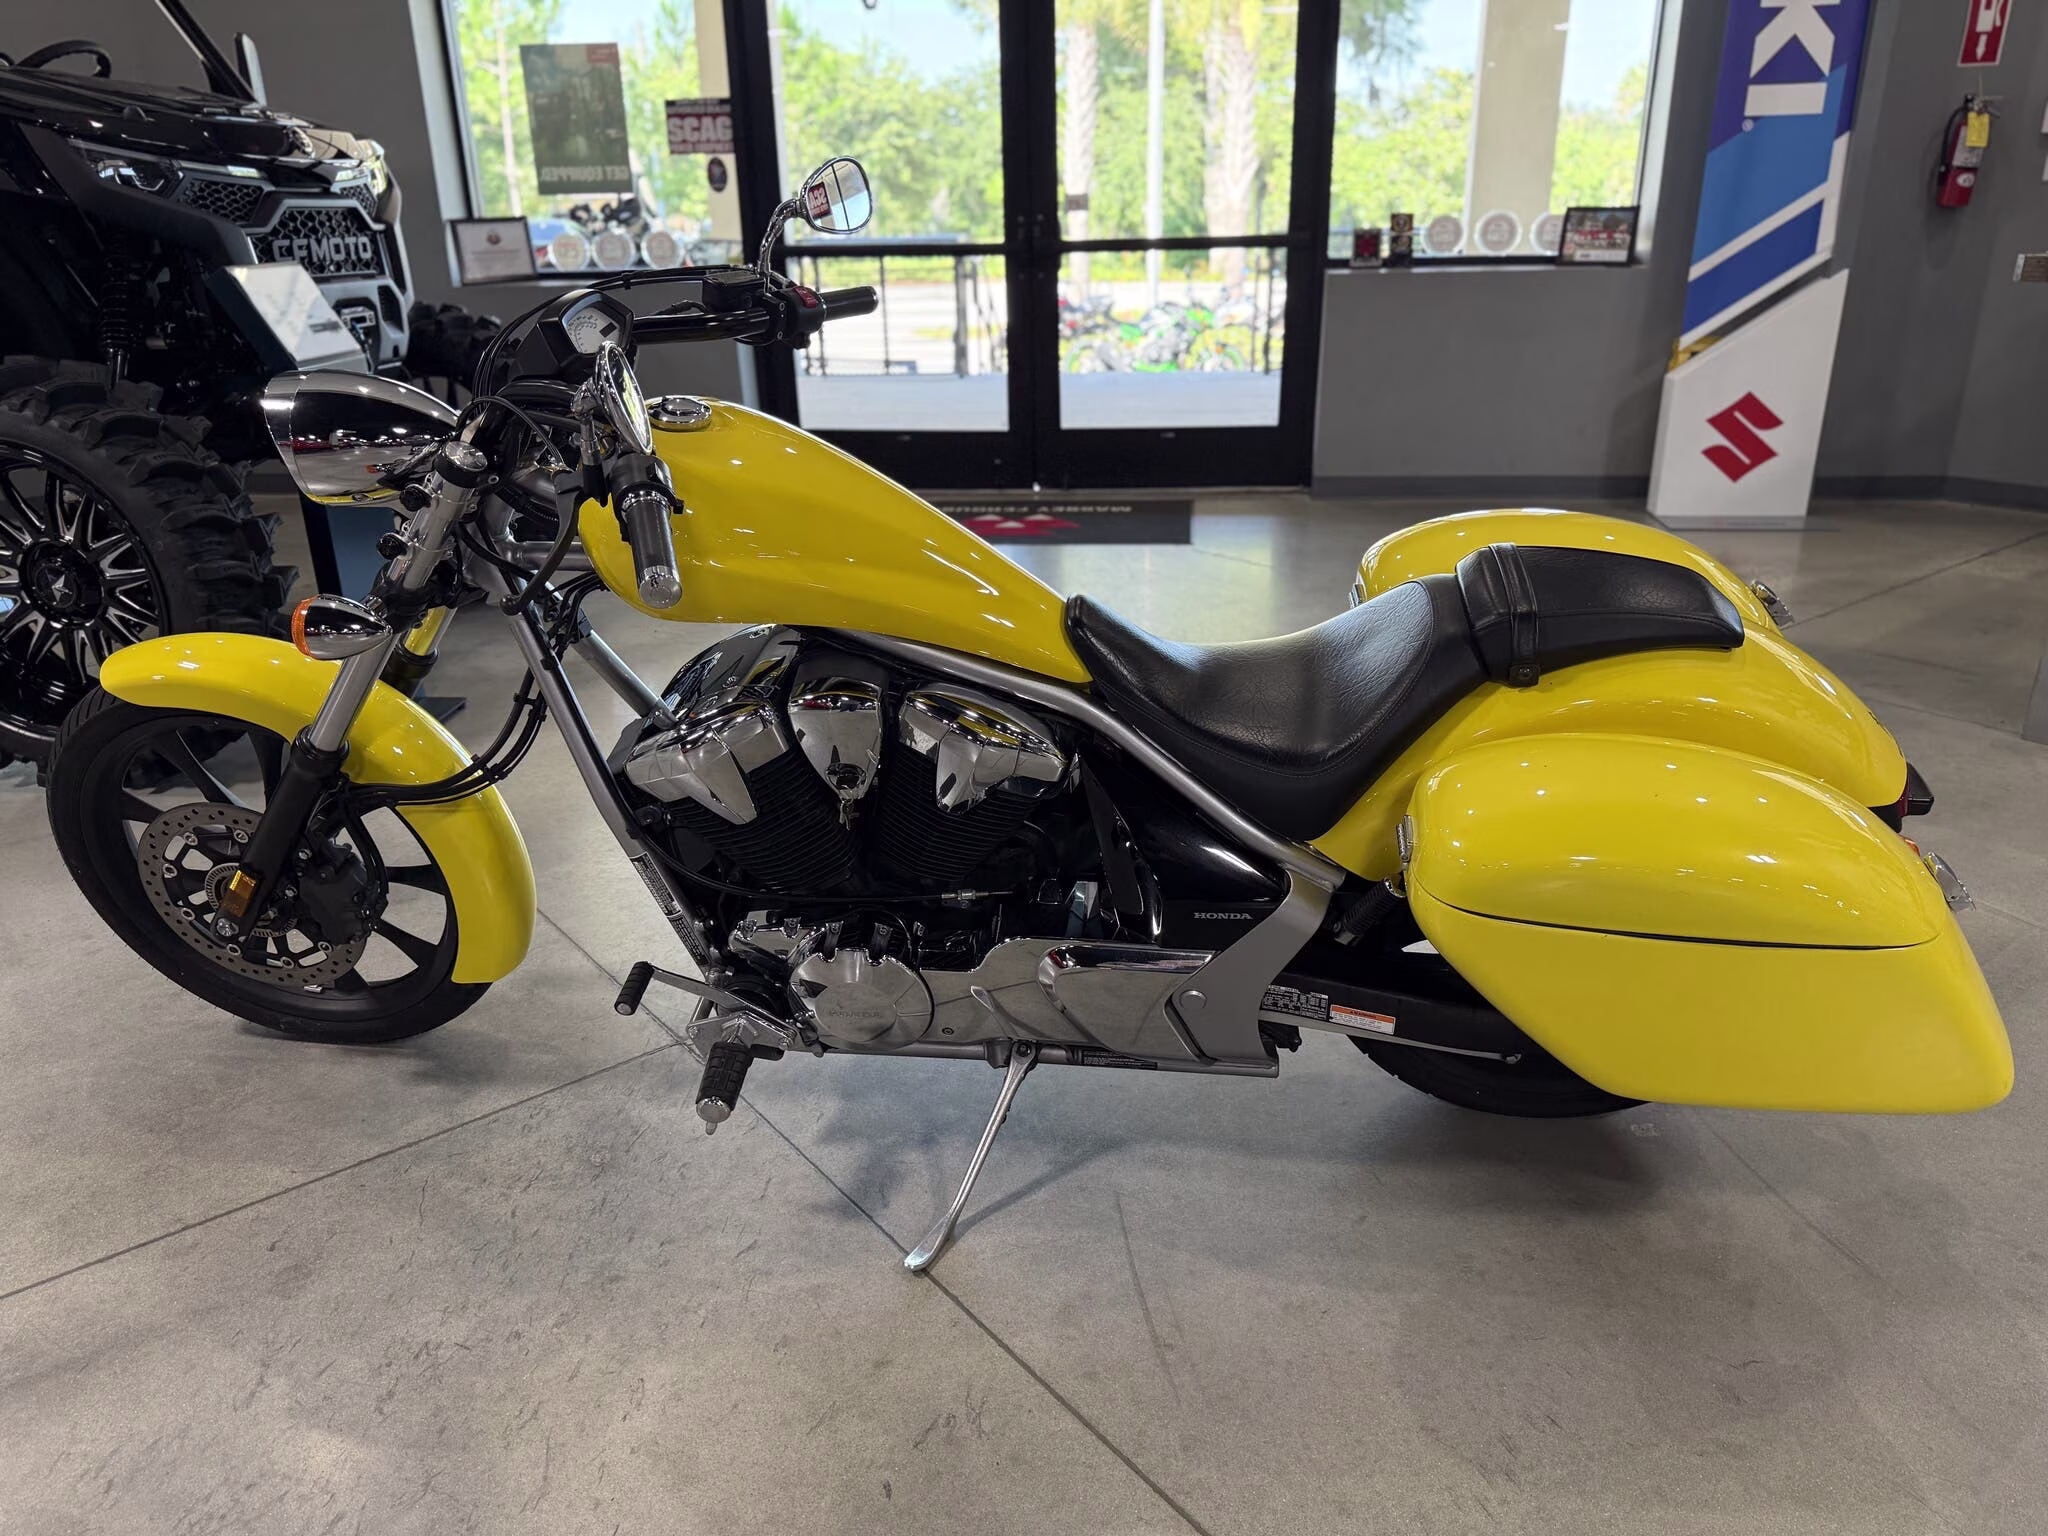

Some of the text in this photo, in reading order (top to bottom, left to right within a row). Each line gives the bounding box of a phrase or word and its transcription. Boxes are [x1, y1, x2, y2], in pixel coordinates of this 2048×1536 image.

[667, 114, 734, 142] SCAG
[271, 236, 372, 263] CFMOTO
[1193, 912, 1254, 920] HONDA
